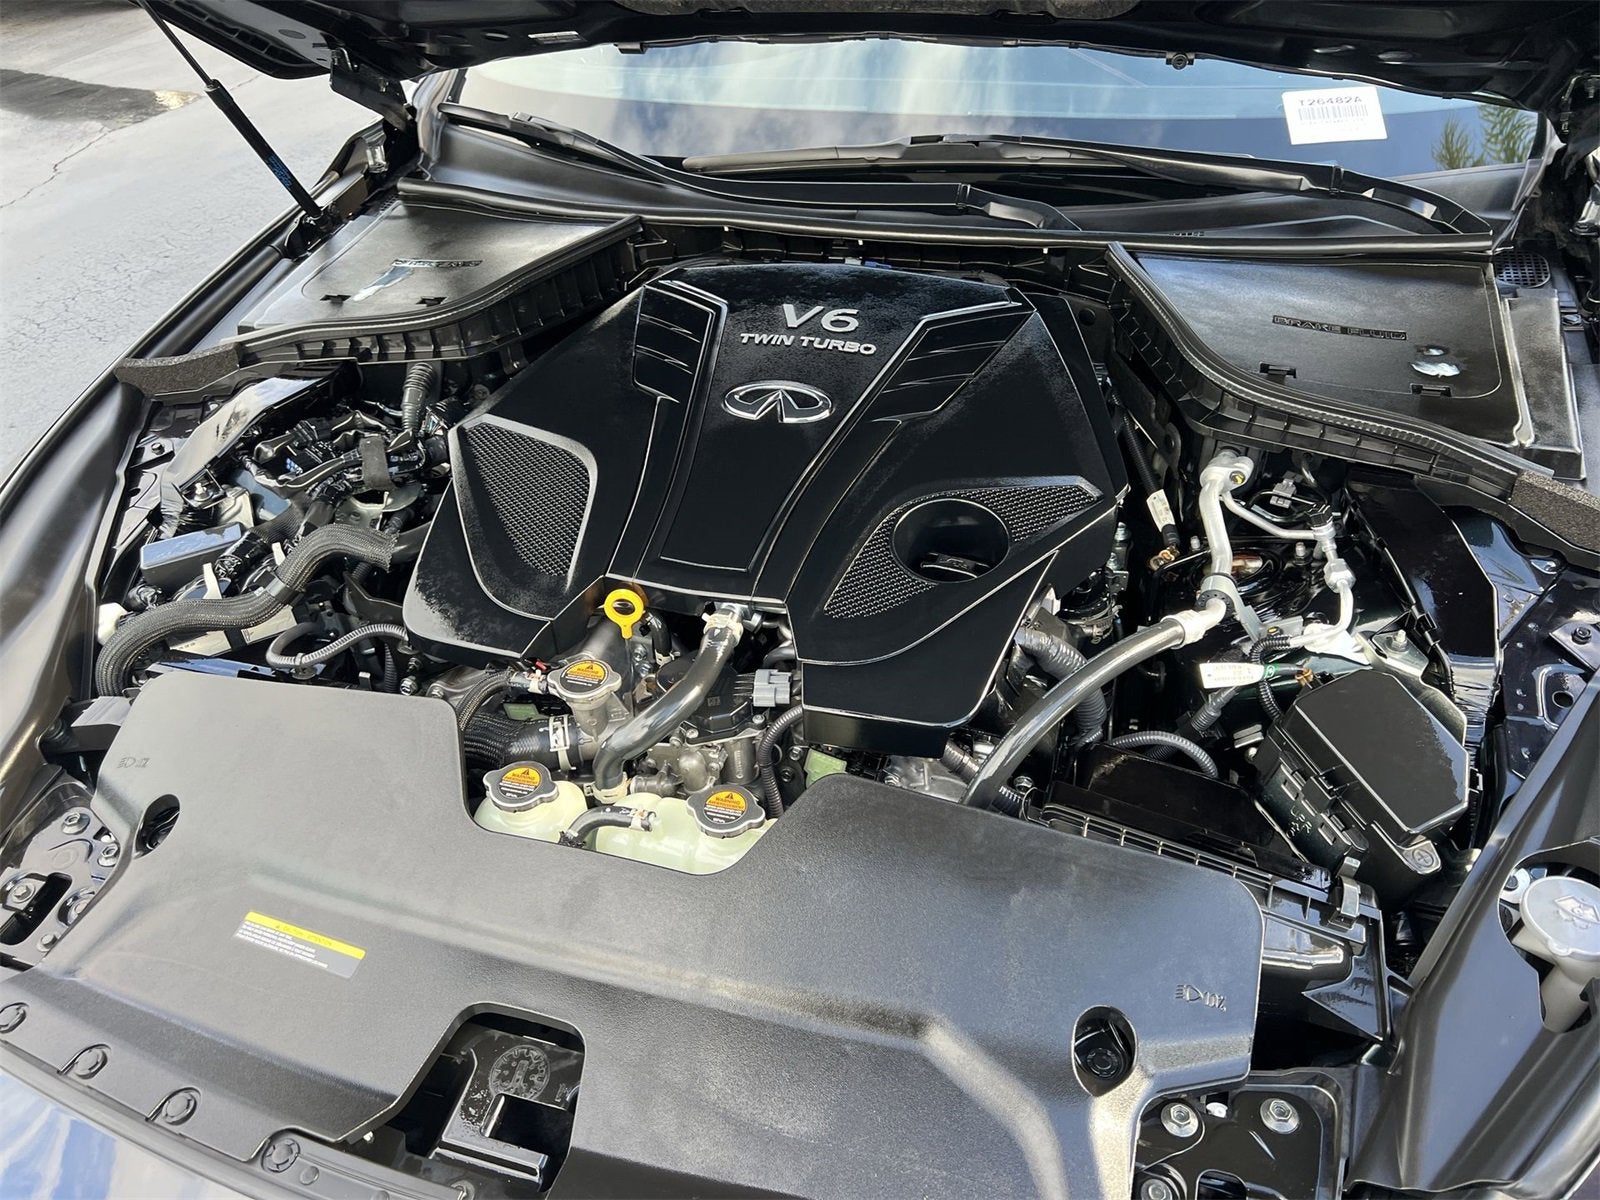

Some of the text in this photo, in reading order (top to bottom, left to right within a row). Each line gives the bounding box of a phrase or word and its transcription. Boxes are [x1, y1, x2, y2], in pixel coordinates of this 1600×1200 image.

[1299, 96, 1363, 106] T26482A
[782, 303, 860, 333] V6
[1274, 315, 1407, 341] BRAKE FLUID
[740, 332, 877, 355] TWIN TURBO
